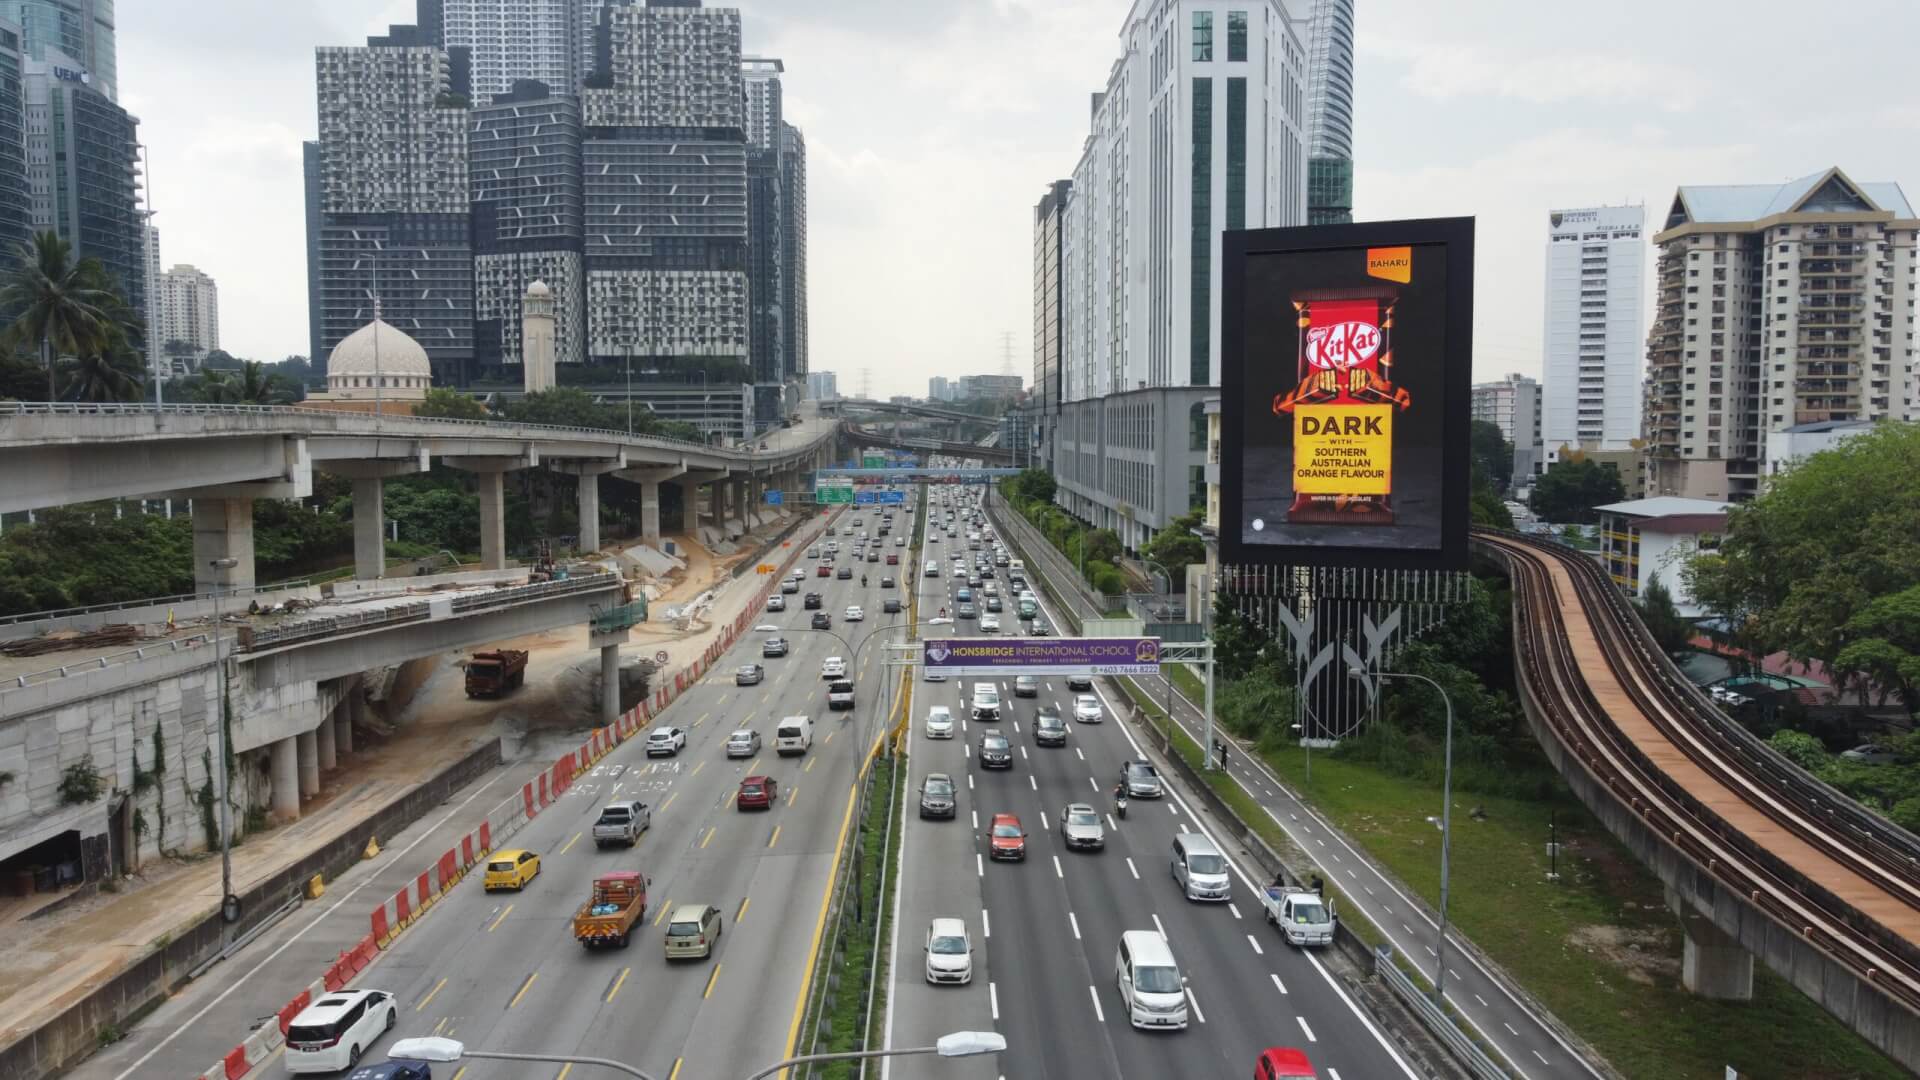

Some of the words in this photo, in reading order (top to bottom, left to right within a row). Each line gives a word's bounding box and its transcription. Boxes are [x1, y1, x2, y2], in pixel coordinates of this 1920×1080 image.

[54, 66, 81, 81] UEM
[1370, 258, 1408, 268] BAHARU
[1316, 323, 1377, 368] KitKat
[1302, 416, 1383, 436] DARK
[1315, 448, 1367, 457] SOUTHERN
[1311, 458, 1371, 468] AUSTRALIAN
[1297, 469, 1338, 478] ORANGE
[1341, 469, 1384, 479] FLAVOUR
[953, 647, 1014, 656] HONSBRIDGE
[1016, 646, 1088, 656] INTERNATIONAL
[1090, 646, 1131, 656] SCHOOL
[1099, 665, 1118, 674] +603
